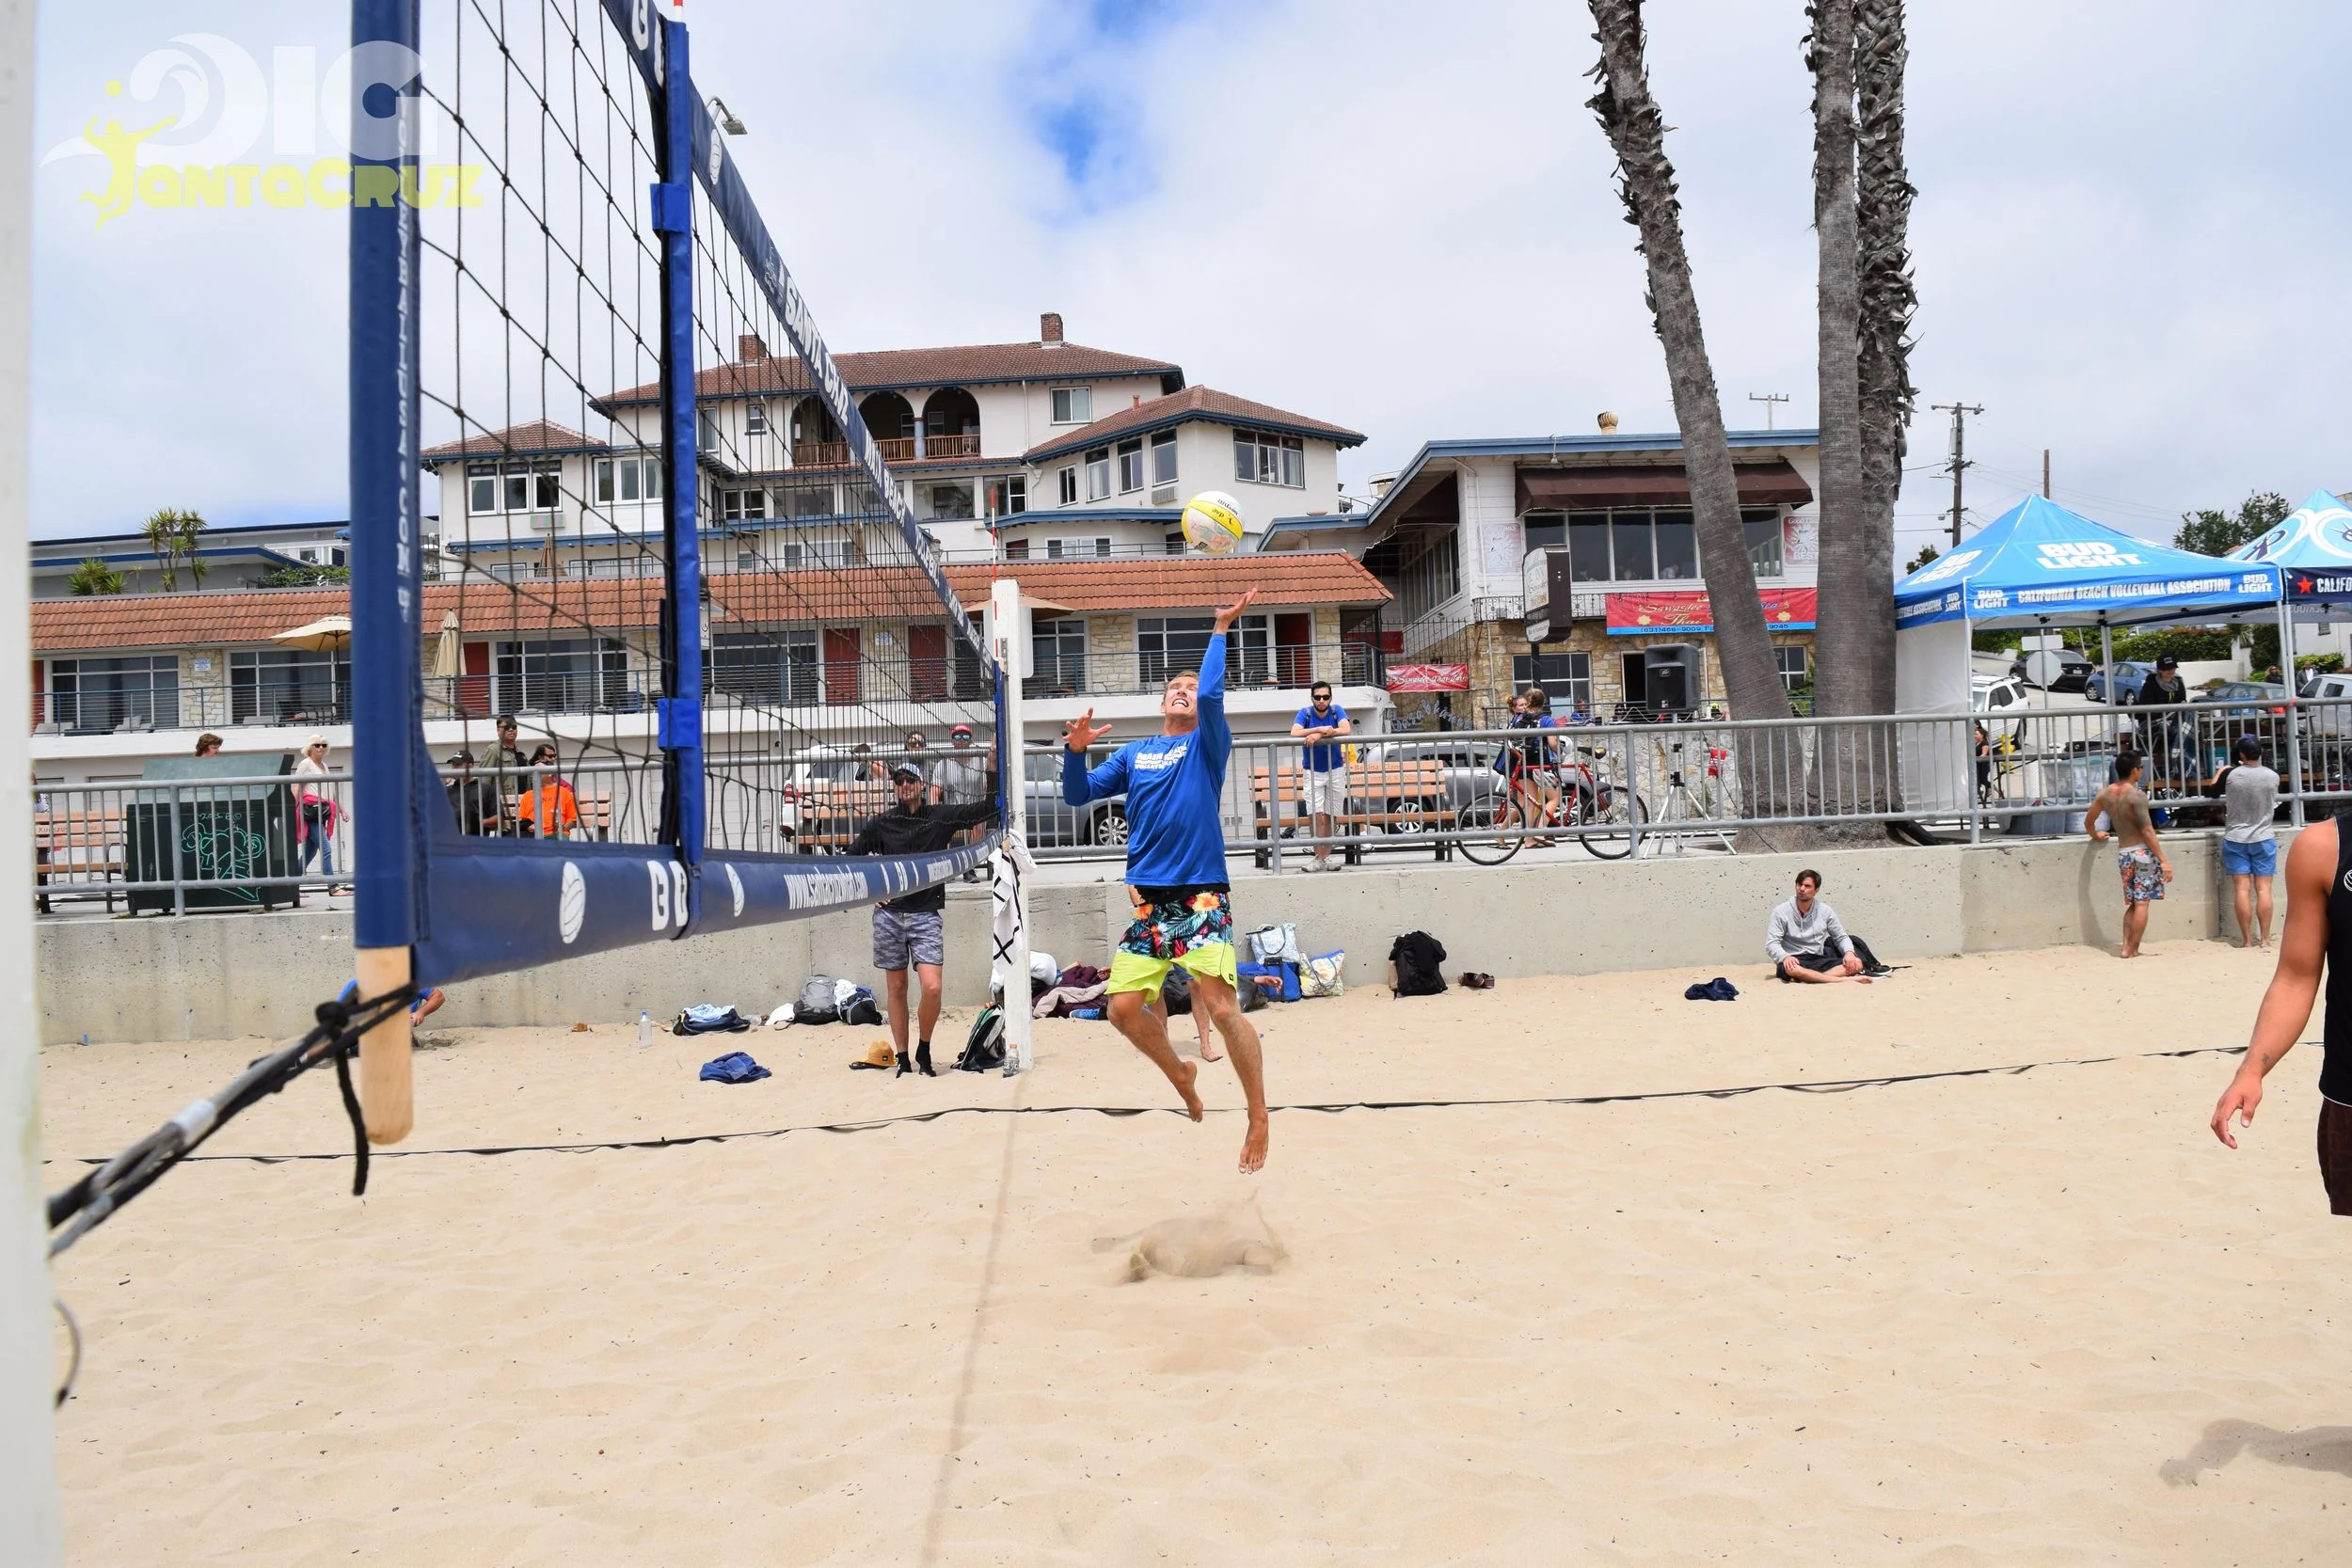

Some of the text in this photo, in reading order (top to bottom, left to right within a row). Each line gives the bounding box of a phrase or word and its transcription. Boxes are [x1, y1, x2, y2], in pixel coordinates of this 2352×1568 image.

[785, 275, 823, 379] SANTA
[883, 467, 907, 528] BEACH
[2037, 542, 2117, 557] BUD
[2036, 553, 2146, 569] LIGHT
[2243, 574, 2268, 583] BUD
[1978, 589, 2004, 599] BUD
[2017, 578, 2232, 604] CALIFORNIA BEACH VOLLEYBALL ASSOCIATION
[2238, 583, 2273, 594] LIGHT
[1947, 592, 1960, 603] BUD
[1973, 597, 2010, 610] LIGHT
[1644, 603, 1703, 612] Sawasdee
[1945, 601, 1962, 612] LIGHT
[1661, 613, 1702, 626] Thai
